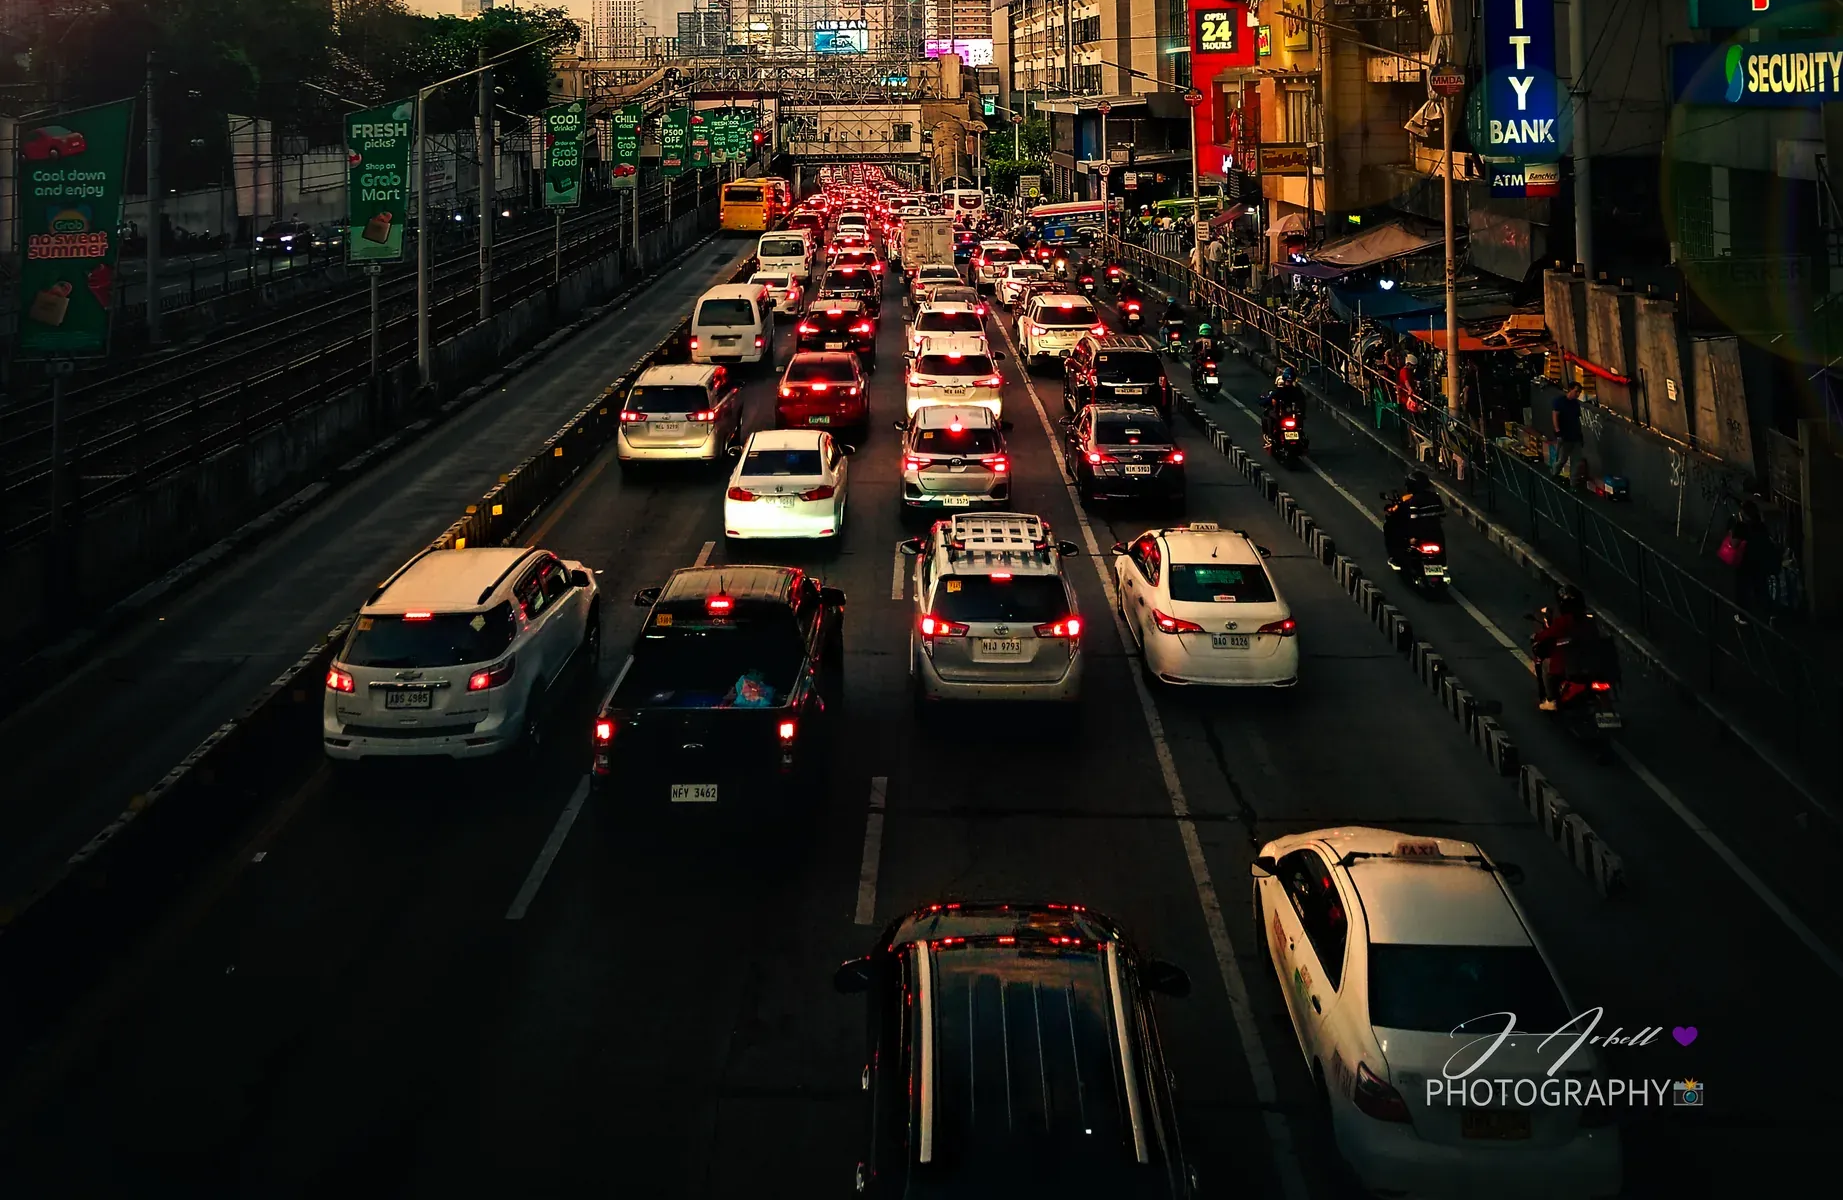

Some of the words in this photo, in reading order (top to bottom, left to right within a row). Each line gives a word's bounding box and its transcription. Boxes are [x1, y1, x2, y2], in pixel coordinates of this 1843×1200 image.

[1204, 12, 1227, 21] OPEN
[816, 19, 868, 30] NISSAN
[1201, 20, 1232, 42] 24
[1202, 41, 1232, 50] HOURS
[1747, 51, 1843, 94] SECURITY
[1431, 75, 1464, 85] MMDA
[550, 114, 581, 125] COOL
[615, 115, 638, 124] CHILL
[352, 122, 408, 139] FRESH
[1489, 118, 1556, 144] BANK
[364, 138, 396, 151] picks?
[617, 141, 636, 150] Grab
[664, 136, 681, 144] OFF
[552, 147, 578, 157] Grab
[620, 149, 634, 157] Car
[365, 163, 385, 171] Shop
[552, 157, 578, 167] Food
[32, 169, 65, 183] Cool
[69, 169, 106, 182] down
[360, 171, 401, 187] Grab
[1493, 174, 1524, 187] ATM
[34, 184, 64, 197] and
[66, 183, 104, 198] enjoy
[362, 188, 401, 202] Mart
[56, 220, 83, 231] Grab
[29, 233, 55, 246] no
[57, 231, 108, 245] sweat
[28, 243, 108, 259] summer
[1001, 642, 1020, 651] 9793
[672, 787, 689, 798] NFY
[694, 787, 716, 798] 3462
[1399, 843, 1437, 856] TAXI
